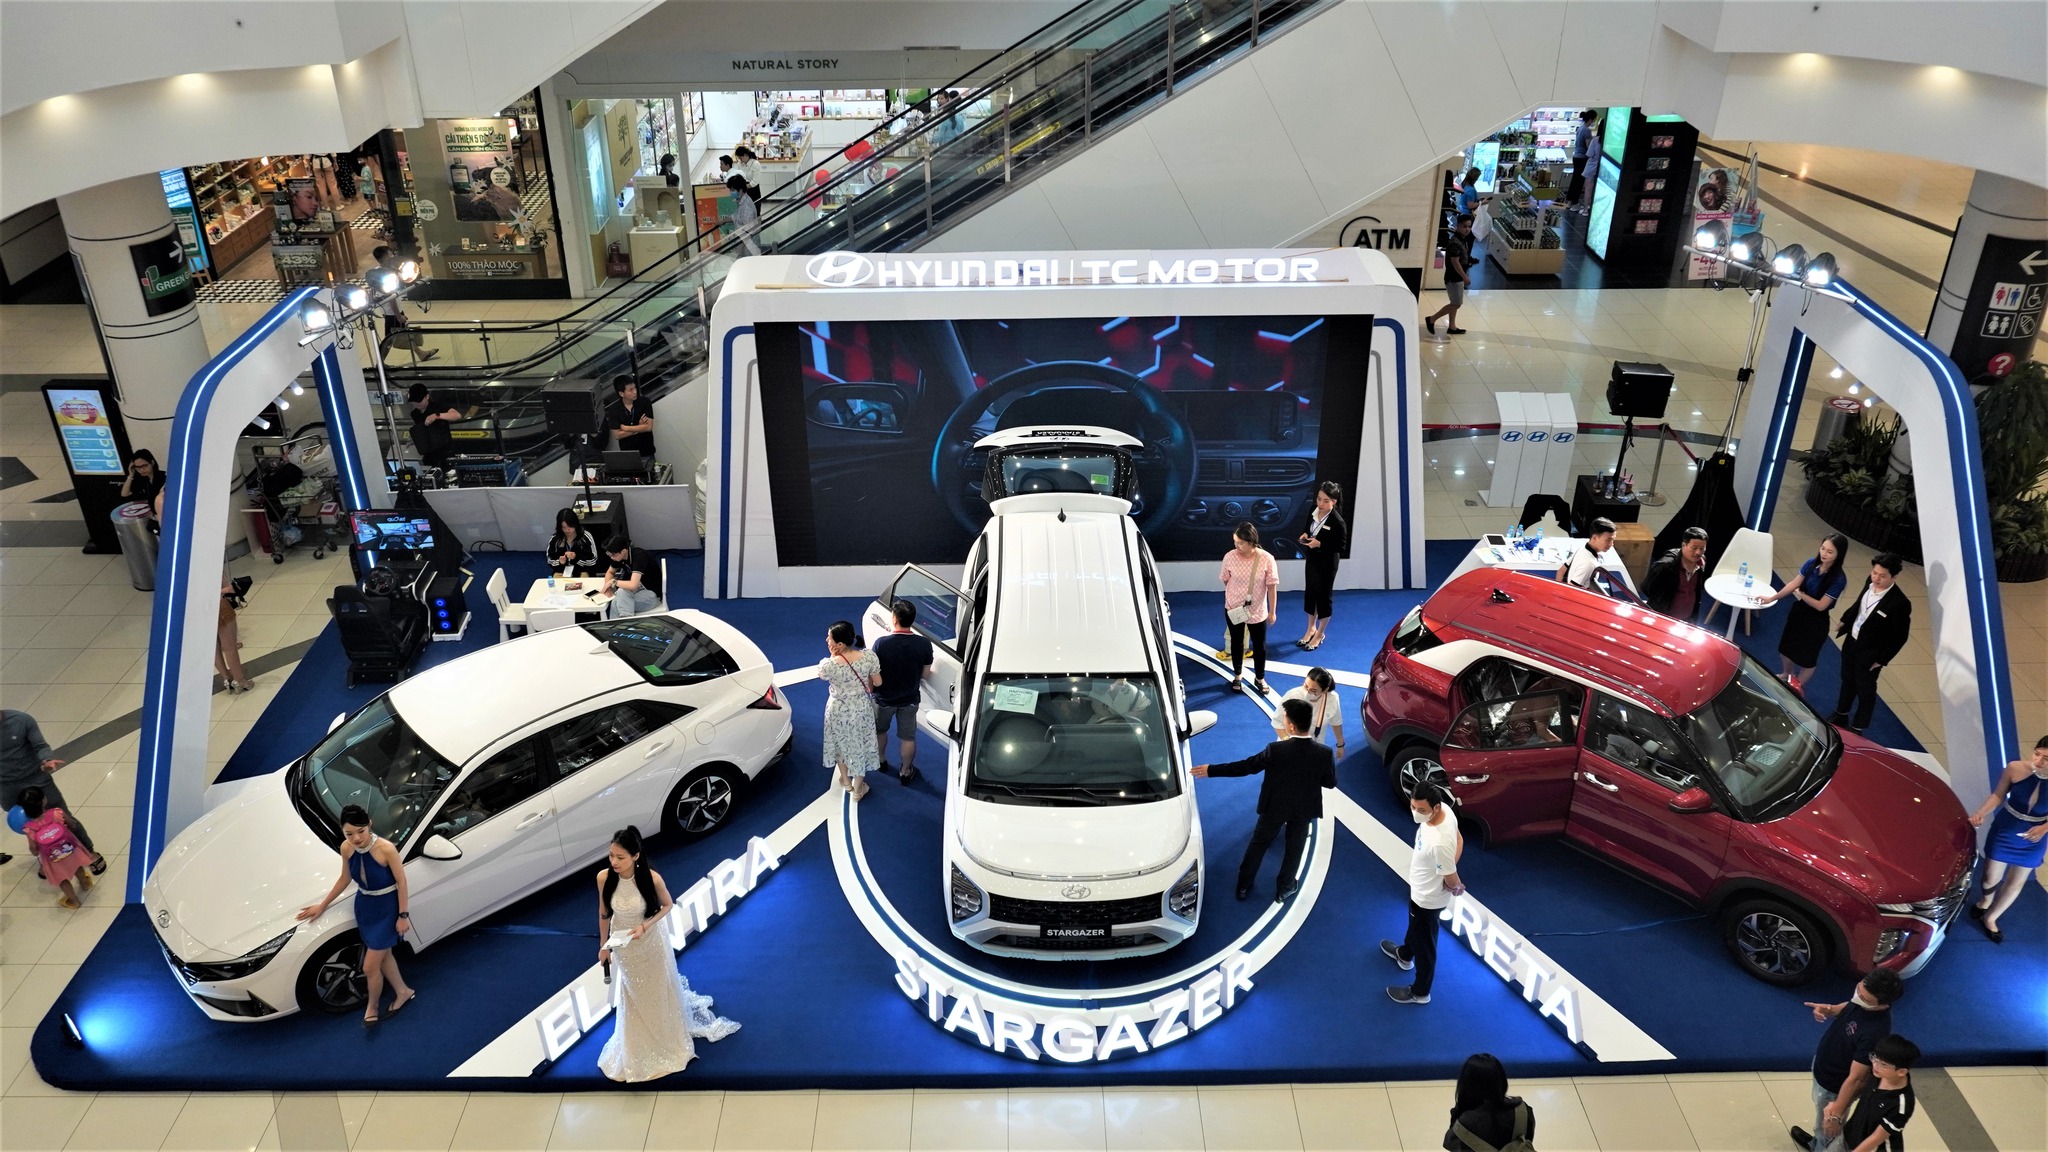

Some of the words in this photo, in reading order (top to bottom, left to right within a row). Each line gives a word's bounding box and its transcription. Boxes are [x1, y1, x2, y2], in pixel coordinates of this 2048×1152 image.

[732, 60, 793, 70] NATURAL
[797, 59, 839, 69] STORY
[474, 135, 479, 143] 5
[1353, 229, 1411, 249] ATM
[281, 255, 317, 265] 43%
[448, 261, 471, 269] 100%
[498, 260, 519, 270] MỘC
[878, 260, 1058, 286] HYUNDAI
[1082, 260, 1138, 284] TC
[1149, 258, 1320, 283] MOTOR
[156, 274, 185, 292] GREEN
[1439, 895, 1584, 1044] RETA
[895, 948, 1254, 1063] STARGAZER
